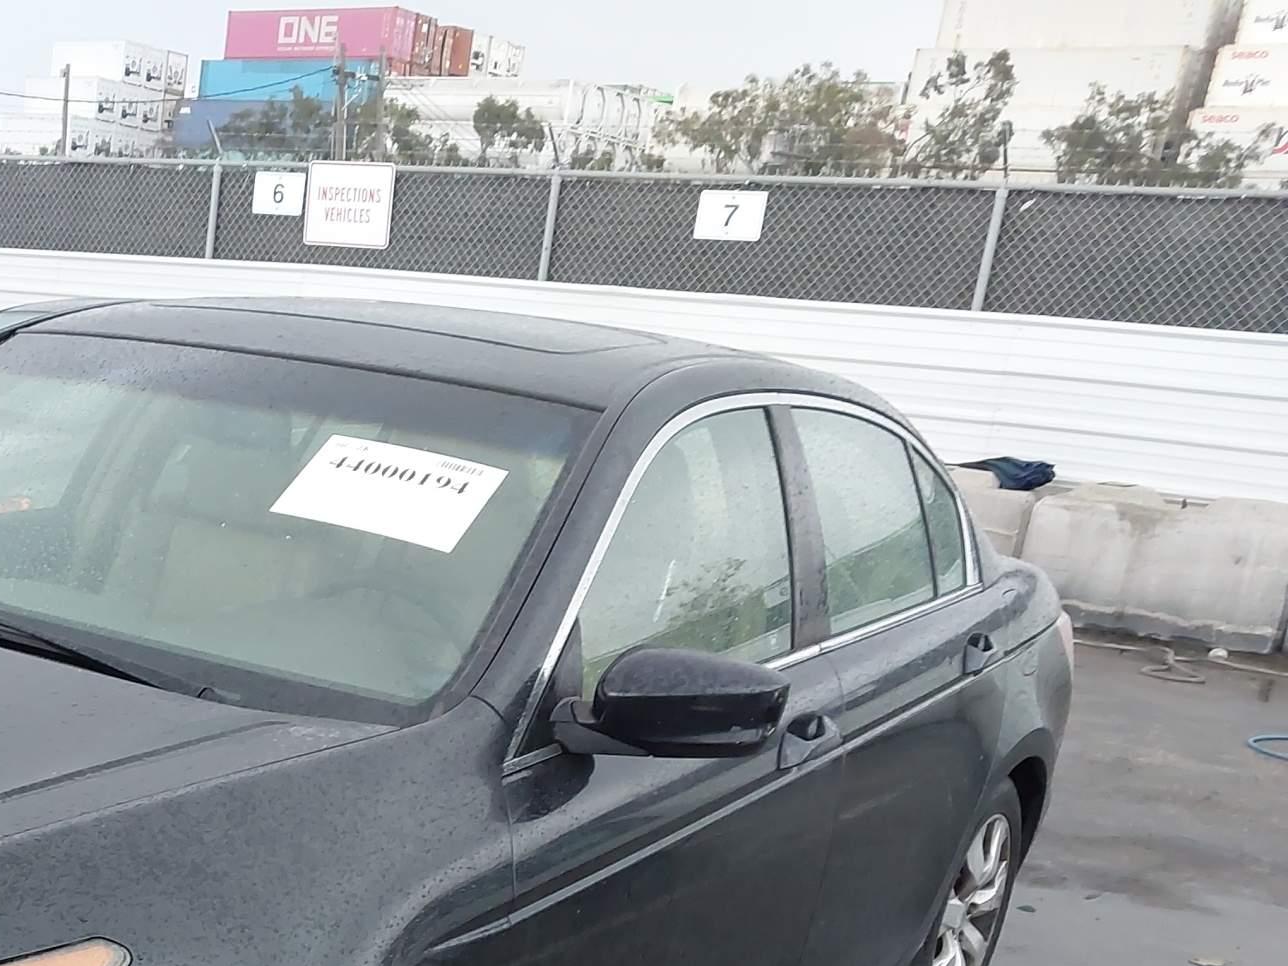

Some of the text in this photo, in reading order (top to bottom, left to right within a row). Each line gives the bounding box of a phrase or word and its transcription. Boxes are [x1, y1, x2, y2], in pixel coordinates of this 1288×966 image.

[278, 15, 339, 43] ONE
[273, 183, 285, 204] 6
[318, 185, 382, 204] INSPECTIONS
[324, 206, 372, 224] VEHICLES
[724, 203, 740, 227] 7
[328, 455, 470, 495] 44000194
